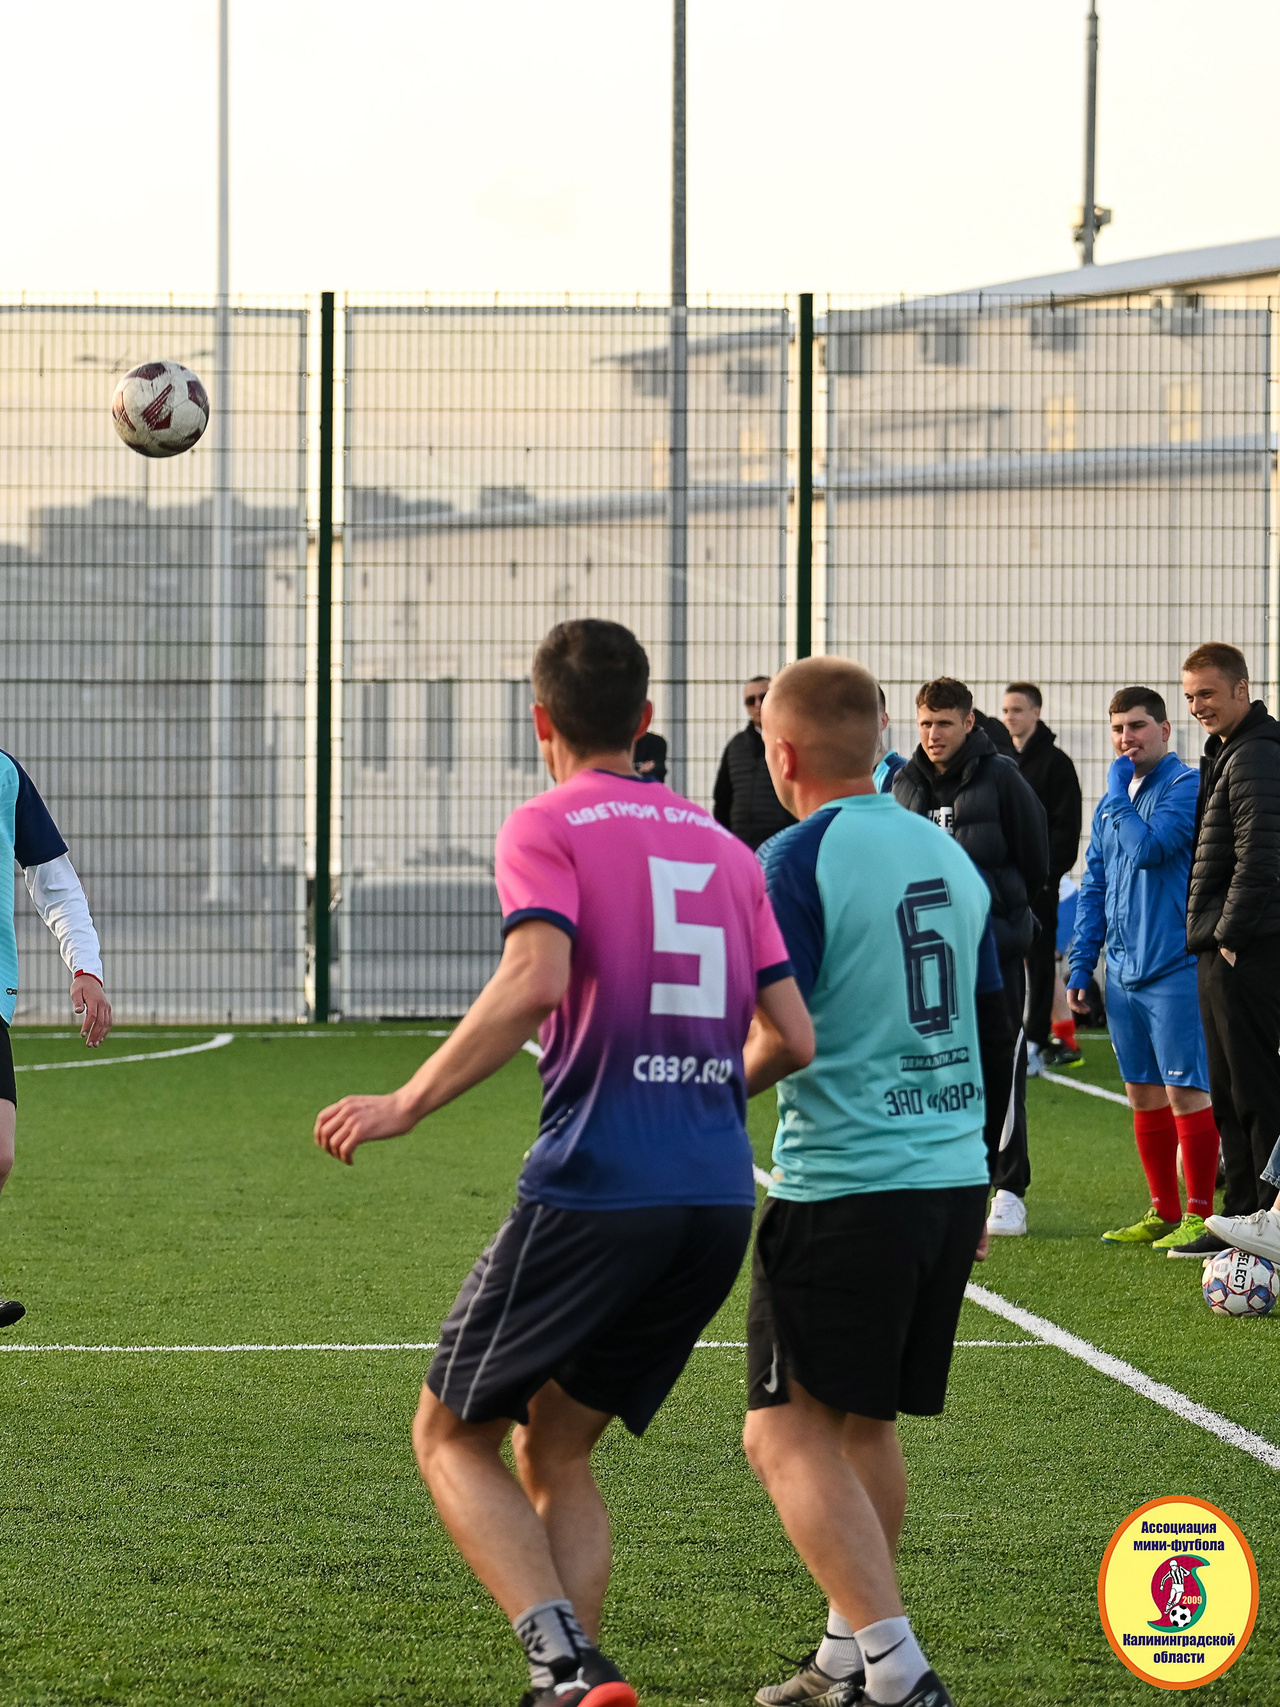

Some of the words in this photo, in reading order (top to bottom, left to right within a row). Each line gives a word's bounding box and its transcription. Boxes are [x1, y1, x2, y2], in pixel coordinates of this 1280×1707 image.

[648, 855, 726, 1019] 5
[895, 877, 959, 1039] 6
[884, 1088, 923, 1116] ЗАО
[1234, 1252, 1250, 1290] SELECT
